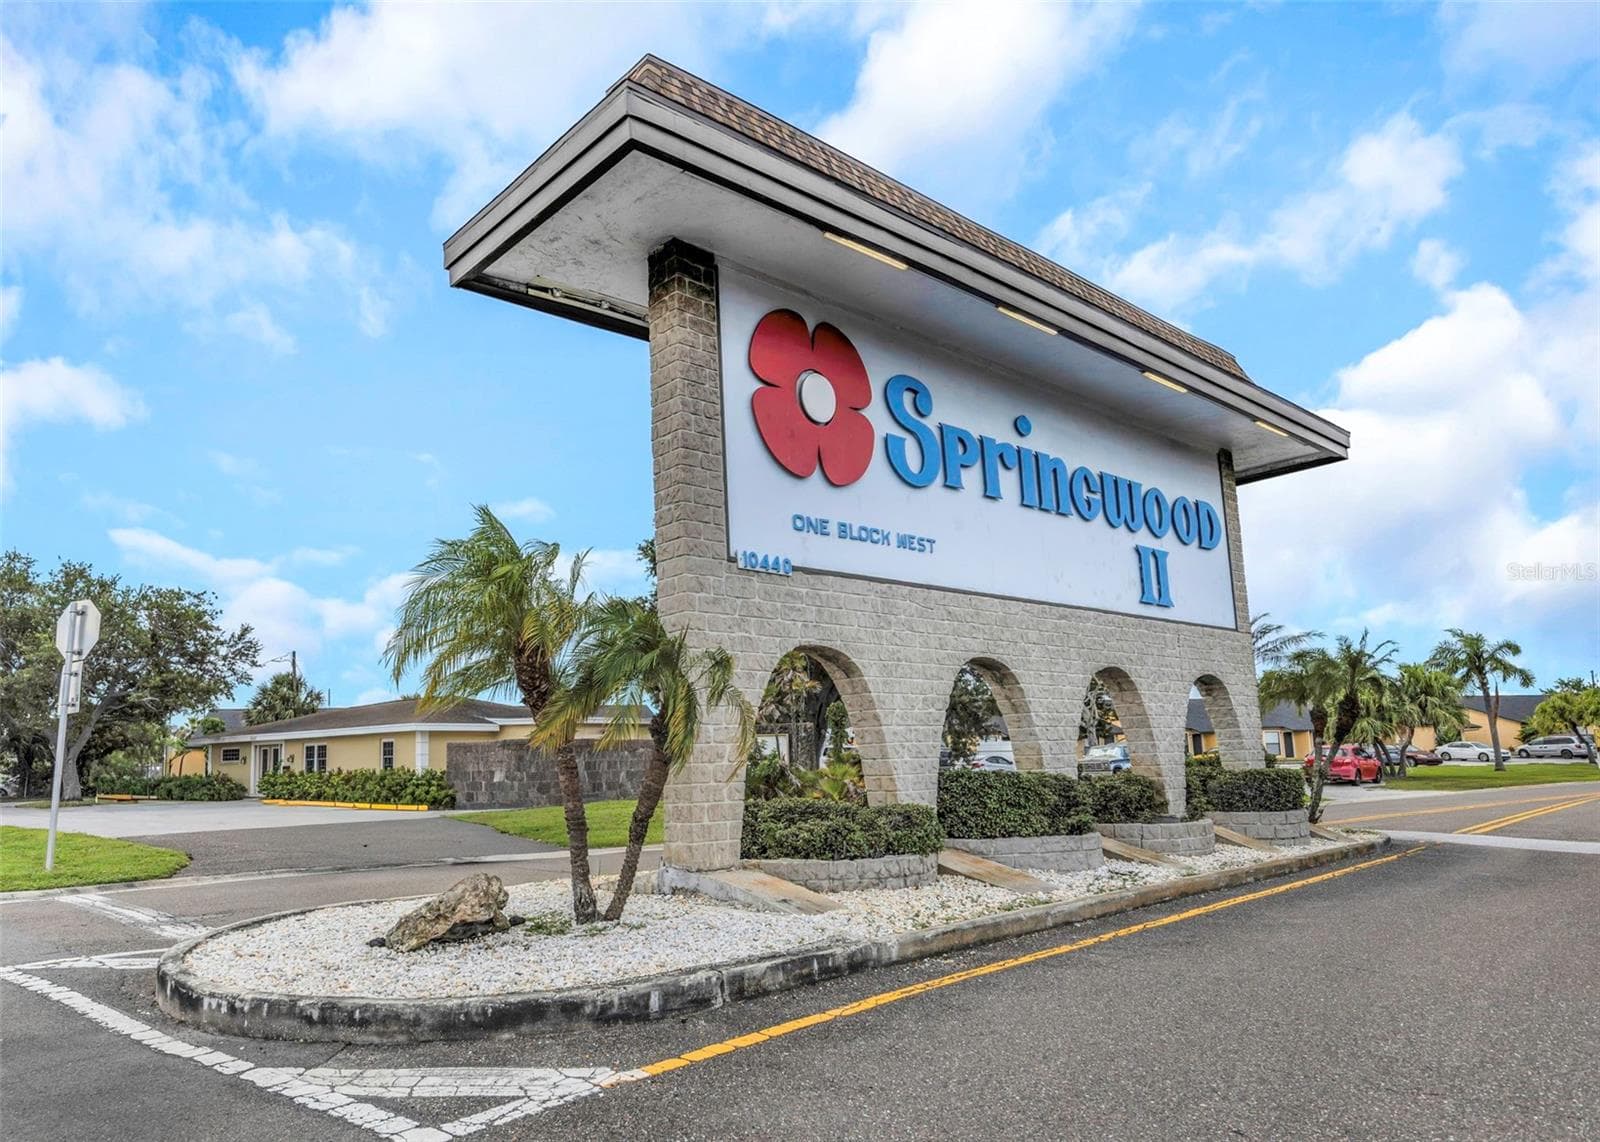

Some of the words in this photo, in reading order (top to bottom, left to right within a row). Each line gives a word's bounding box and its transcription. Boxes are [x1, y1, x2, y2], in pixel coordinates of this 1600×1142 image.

[792, 514, 830, 536] ONE
[837, 521, 891, 546] BLOCK
[897, 532, 936, 554] WEST
[742, 550, 792, 575] 10440
[1135, 544, 1174, 607] II
